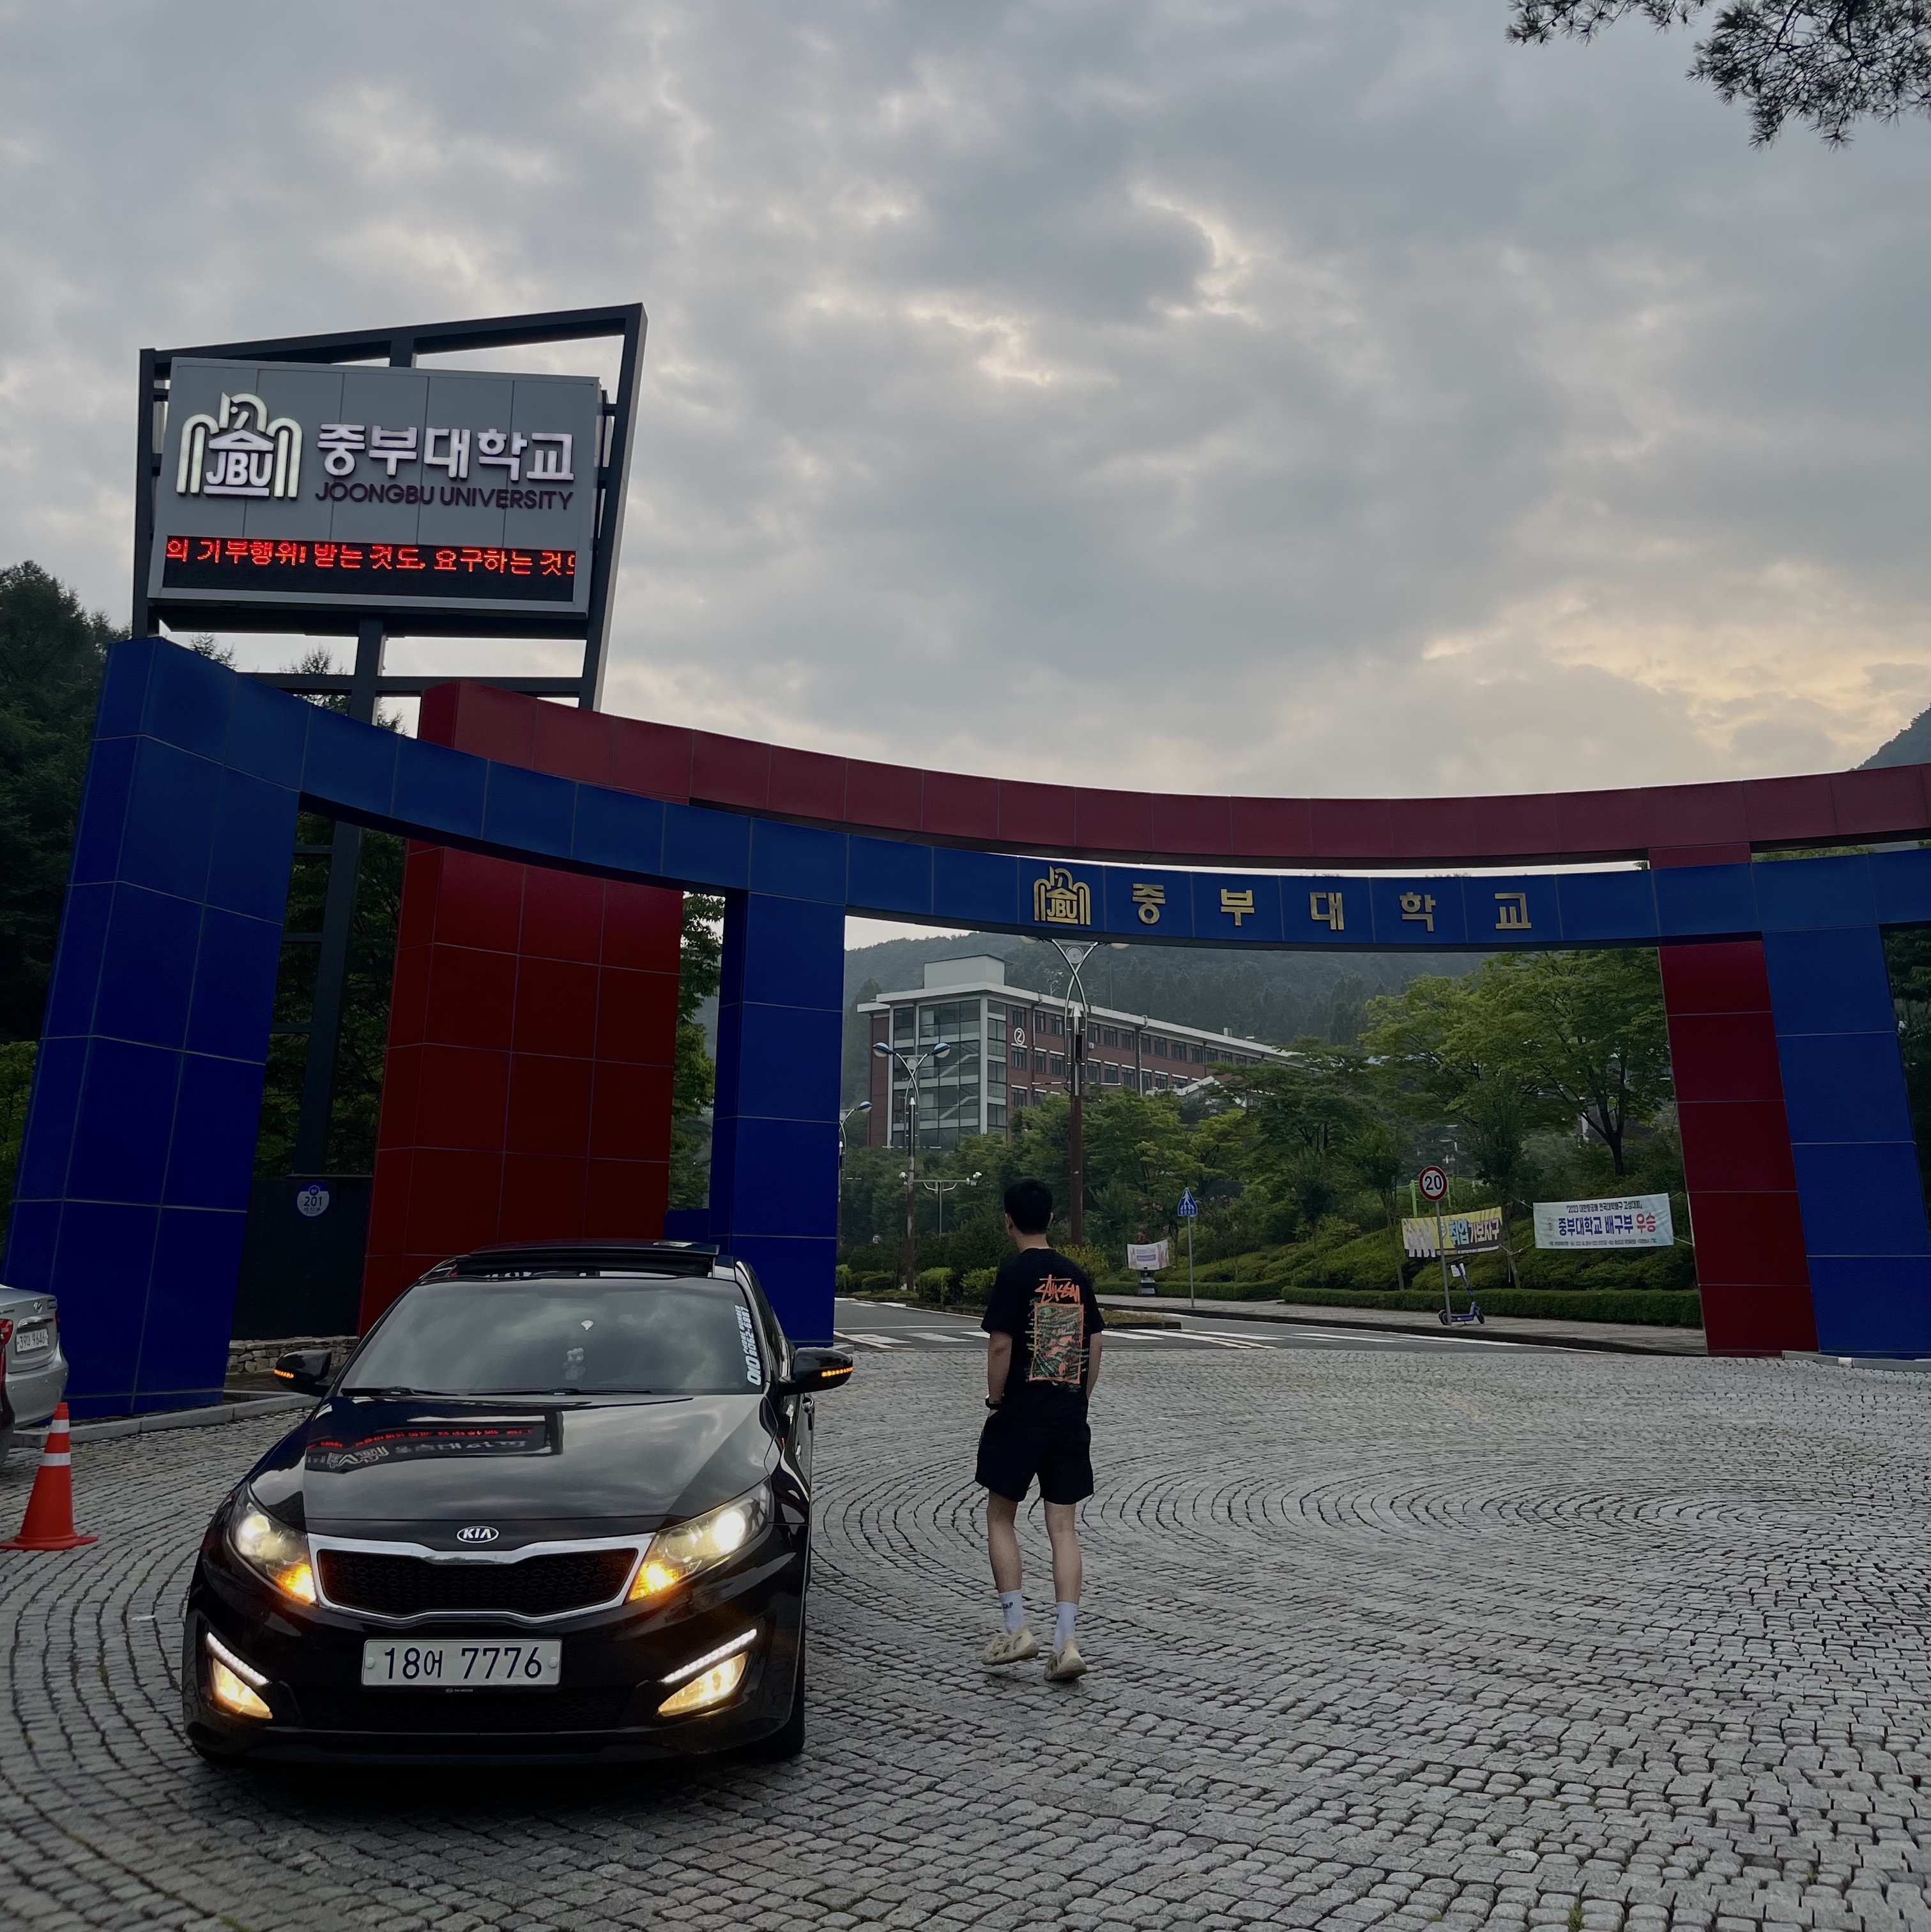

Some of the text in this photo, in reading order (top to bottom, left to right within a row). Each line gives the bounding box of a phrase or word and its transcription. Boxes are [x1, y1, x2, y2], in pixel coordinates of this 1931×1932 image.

[316, 423, 575, 482] 중부대학교
[205, 450, 273, 487] JBU
[315, 481, 574, 510] JOONGBU UNIVERSITY
[166, 538, 189, 563] 의
[314, 543, 363, 568] 받는
[433, 549, 533, 574] 요구하는
[1046, 899, 1078, 918] JBU
[1424, 1175, 1442, 1190] 20
[303, 1196, 323, 1207] 201
[1448, 1219, 1469, 1245] 취업
[1558, 1212, 1656, 1236] 중부대학교 배구부 우승
[735, 1305, 749, 1355] PHONE NUMBER
[745, 1355, 761, 1386] 010
[462, 1528, 492, 1539] KIA
[384, 1647, 542, 1680] 18어 7776
